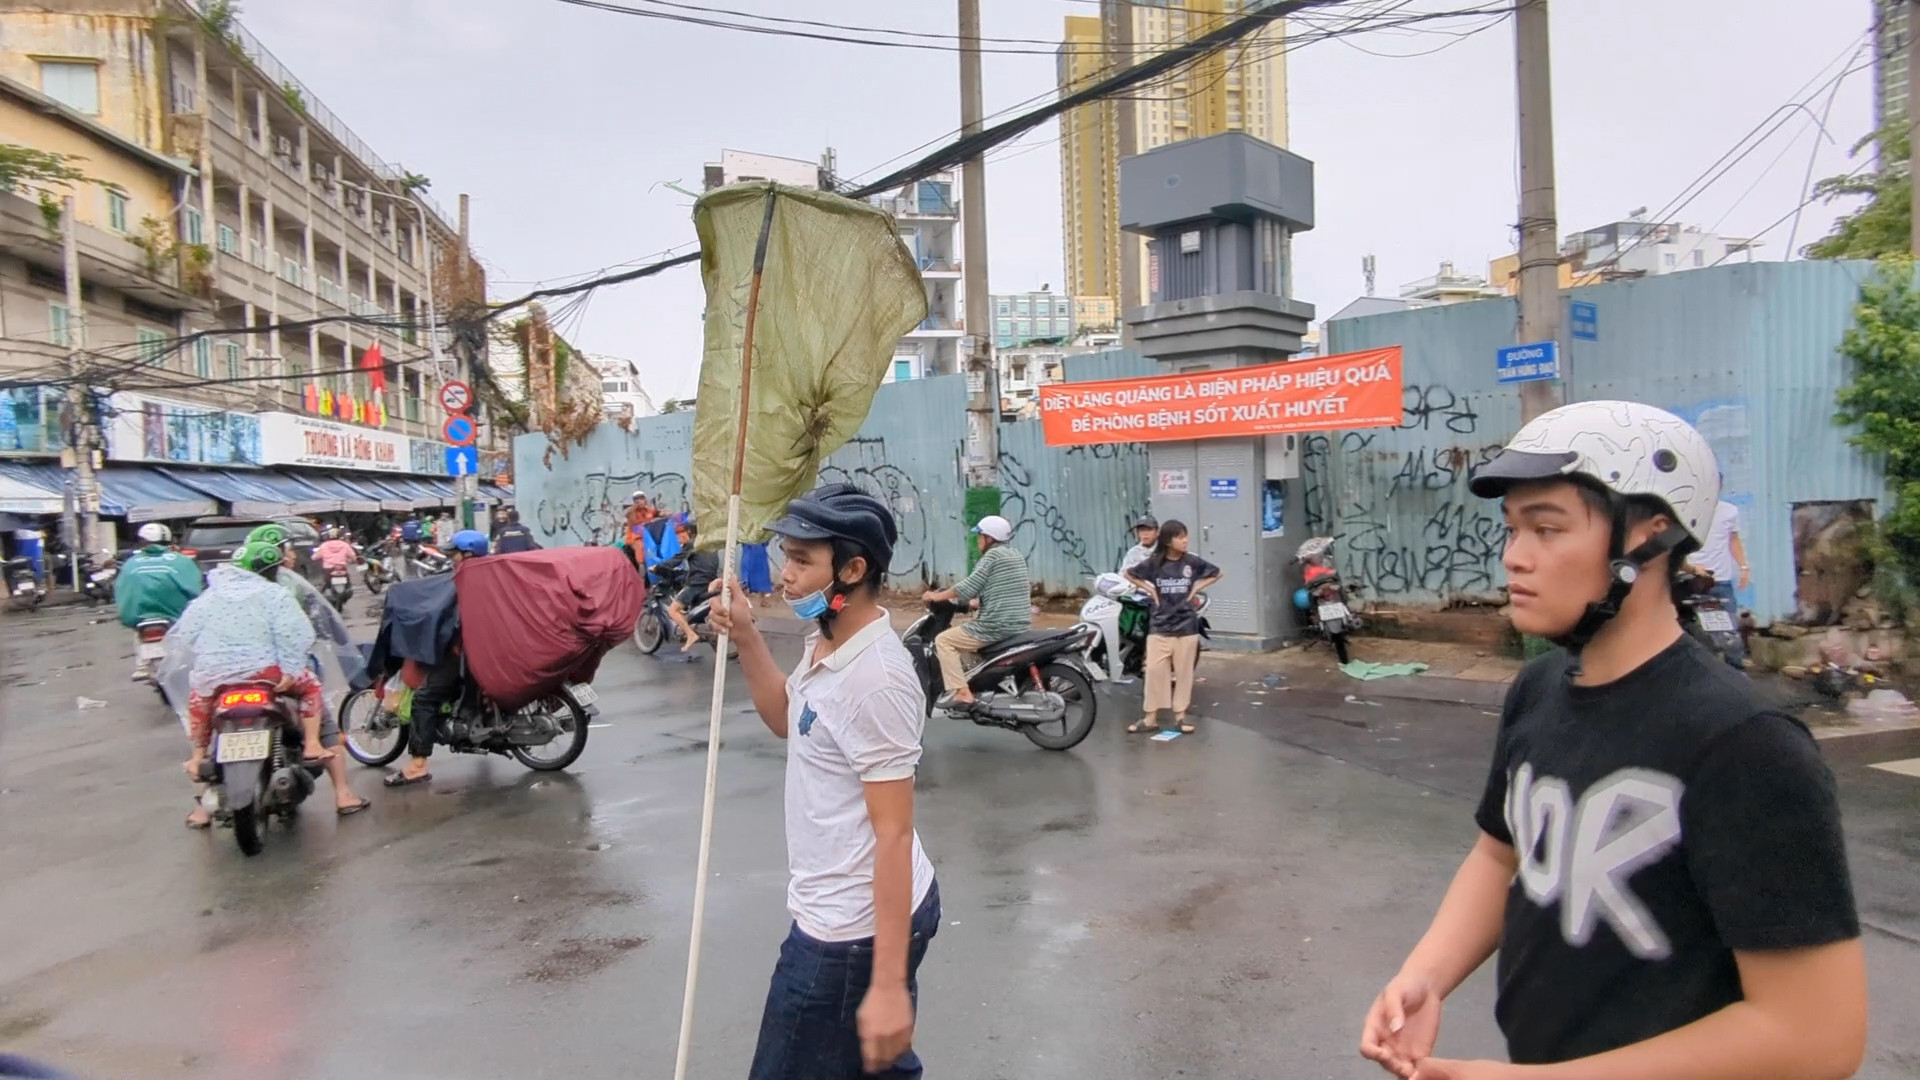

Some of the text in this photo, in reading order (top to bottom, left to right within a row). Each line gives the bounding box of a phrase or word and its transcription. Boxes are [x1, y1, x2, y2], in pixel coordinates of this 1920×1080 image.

[1043, 359, 1392, 413] DIỆT LĂNG QUĂNG LÀ BIỆN PHÁP HIỆU QUẢ
[1092, 412, 1145, 432] PHÒNG
[1147, 408, 1191, 430] BỆNH
[1194, 402, 1229, 424] SỐT
[1231, 398, 1281, 422] XUẤT
[1285, 392, 1349, 417] HUYẾT
